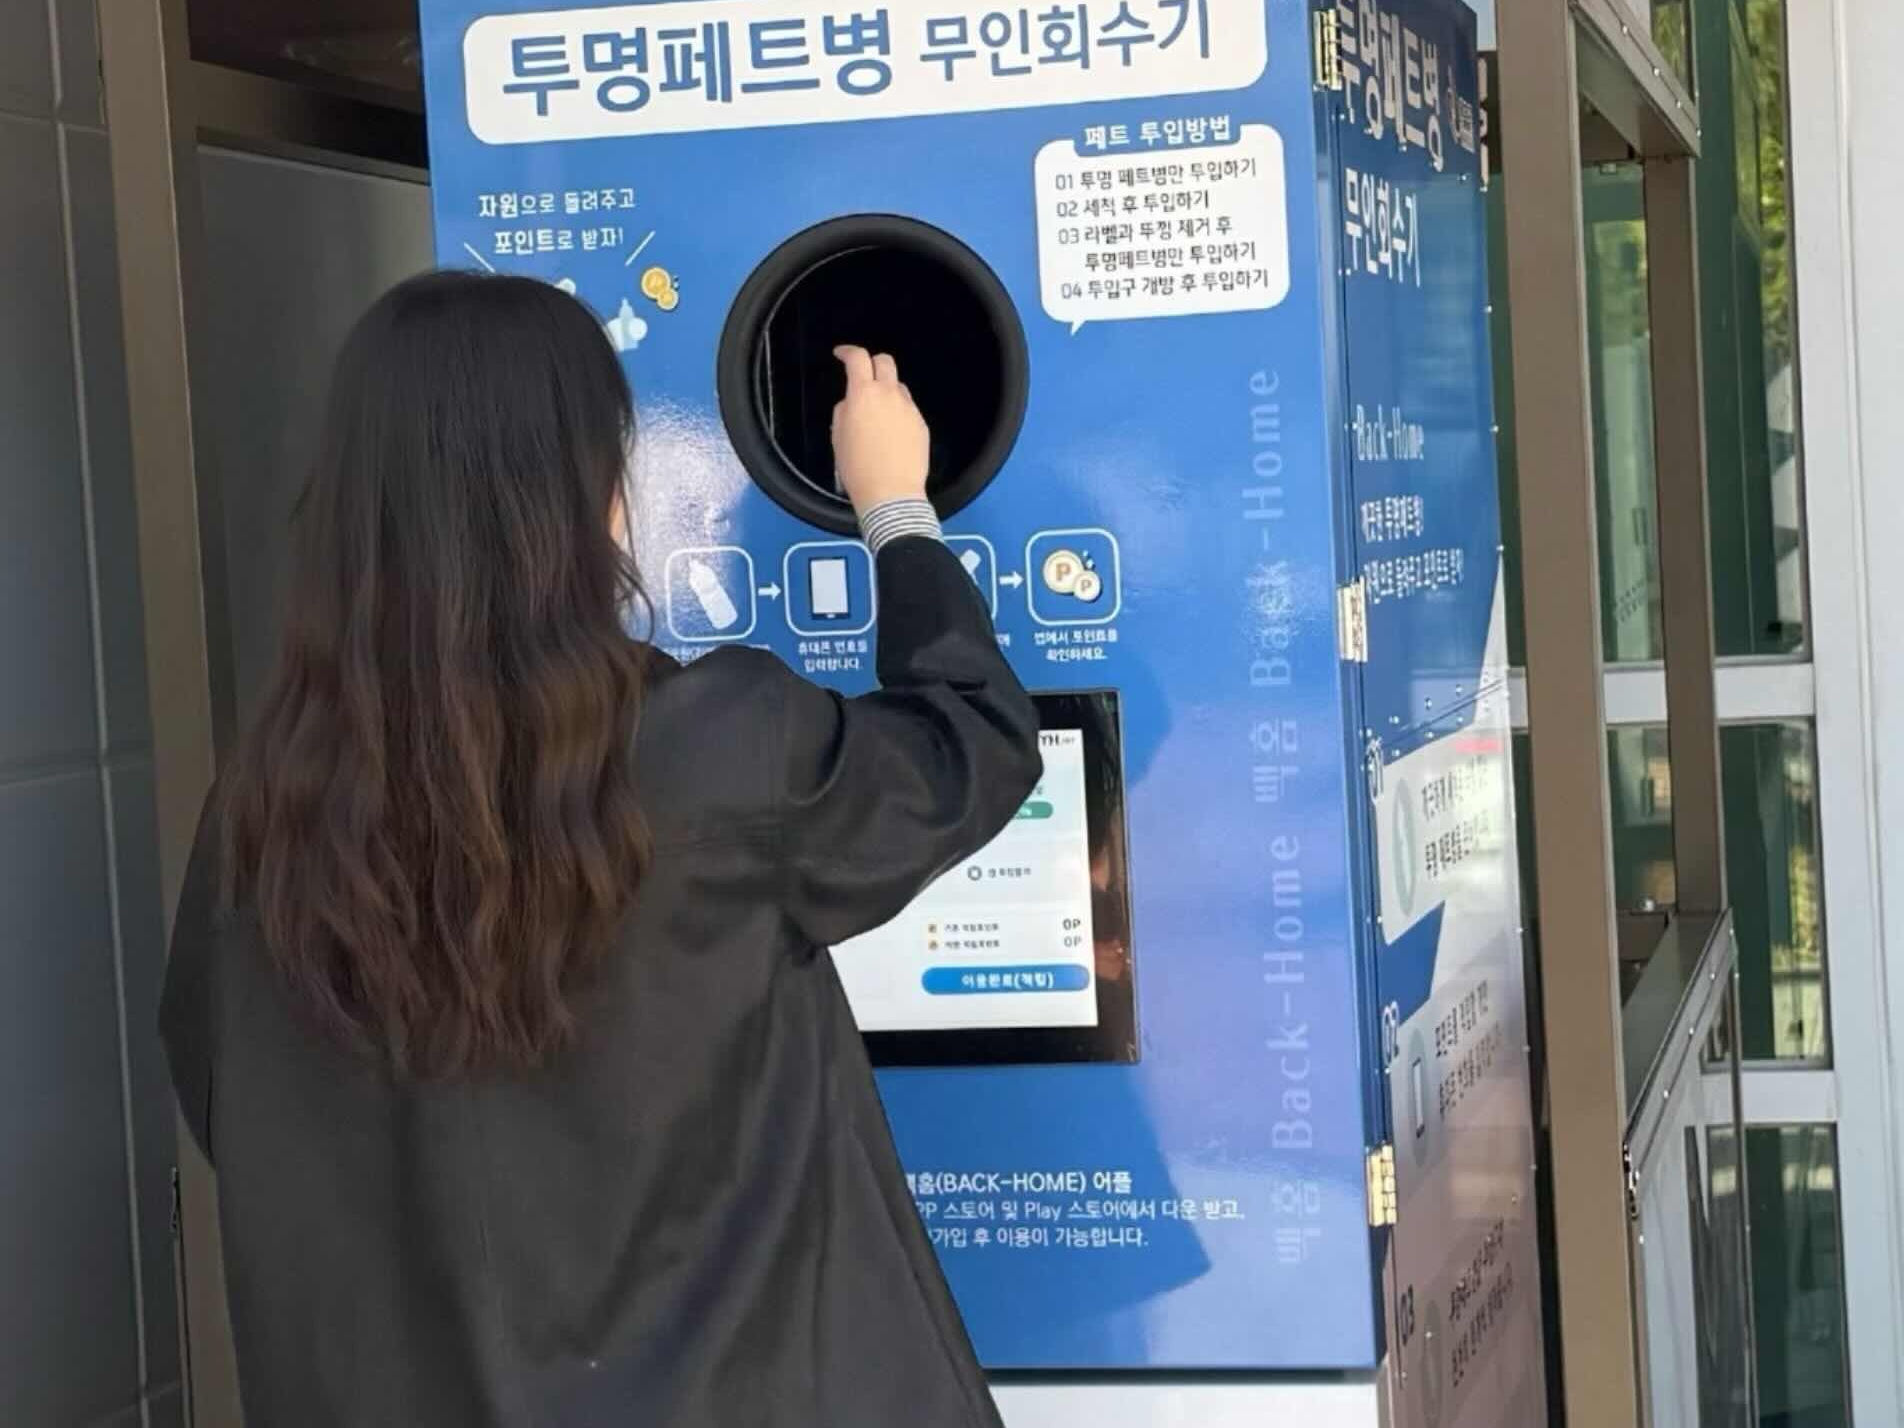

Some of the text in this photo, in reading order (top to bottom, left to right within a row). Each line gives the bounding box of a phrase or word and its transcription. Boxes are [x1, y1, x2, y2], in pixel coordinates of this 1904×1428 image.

[503, 9, 892, 115] 투명페트병
[1140, 115, 1230, 145] 투입방법
[1056, 173, 1074, 190] 01
[478, 192, 555, 218] 자원으로
[1057, 200, 1078, 217] 02
[1122, 194, 1138, 214] 후
[1058, 227, 1079, 245] 03
[1216, 216, 1232, 235] 후
[1346, 168, 1421, 287] 무인회수기
[494, 228, 574, 255] 포인트로
[1061, 282, 1082, 300] 04
[1181, 273, 1196, 294] 후
[1093, 1171, 1132, 1194] 어플
[944, 1200, 994, 1220] 스토어
[1002, 1200, 1018, 1220] 및
[1025, 1201, 1061, 1221] Play
[1068, 1199, 1156, 1220] 스토어에서
[1162, 1199, 1196, 1220] 다운
[927, 1227, 1149, 1248] 가입 후 이용이 가능합니다.
